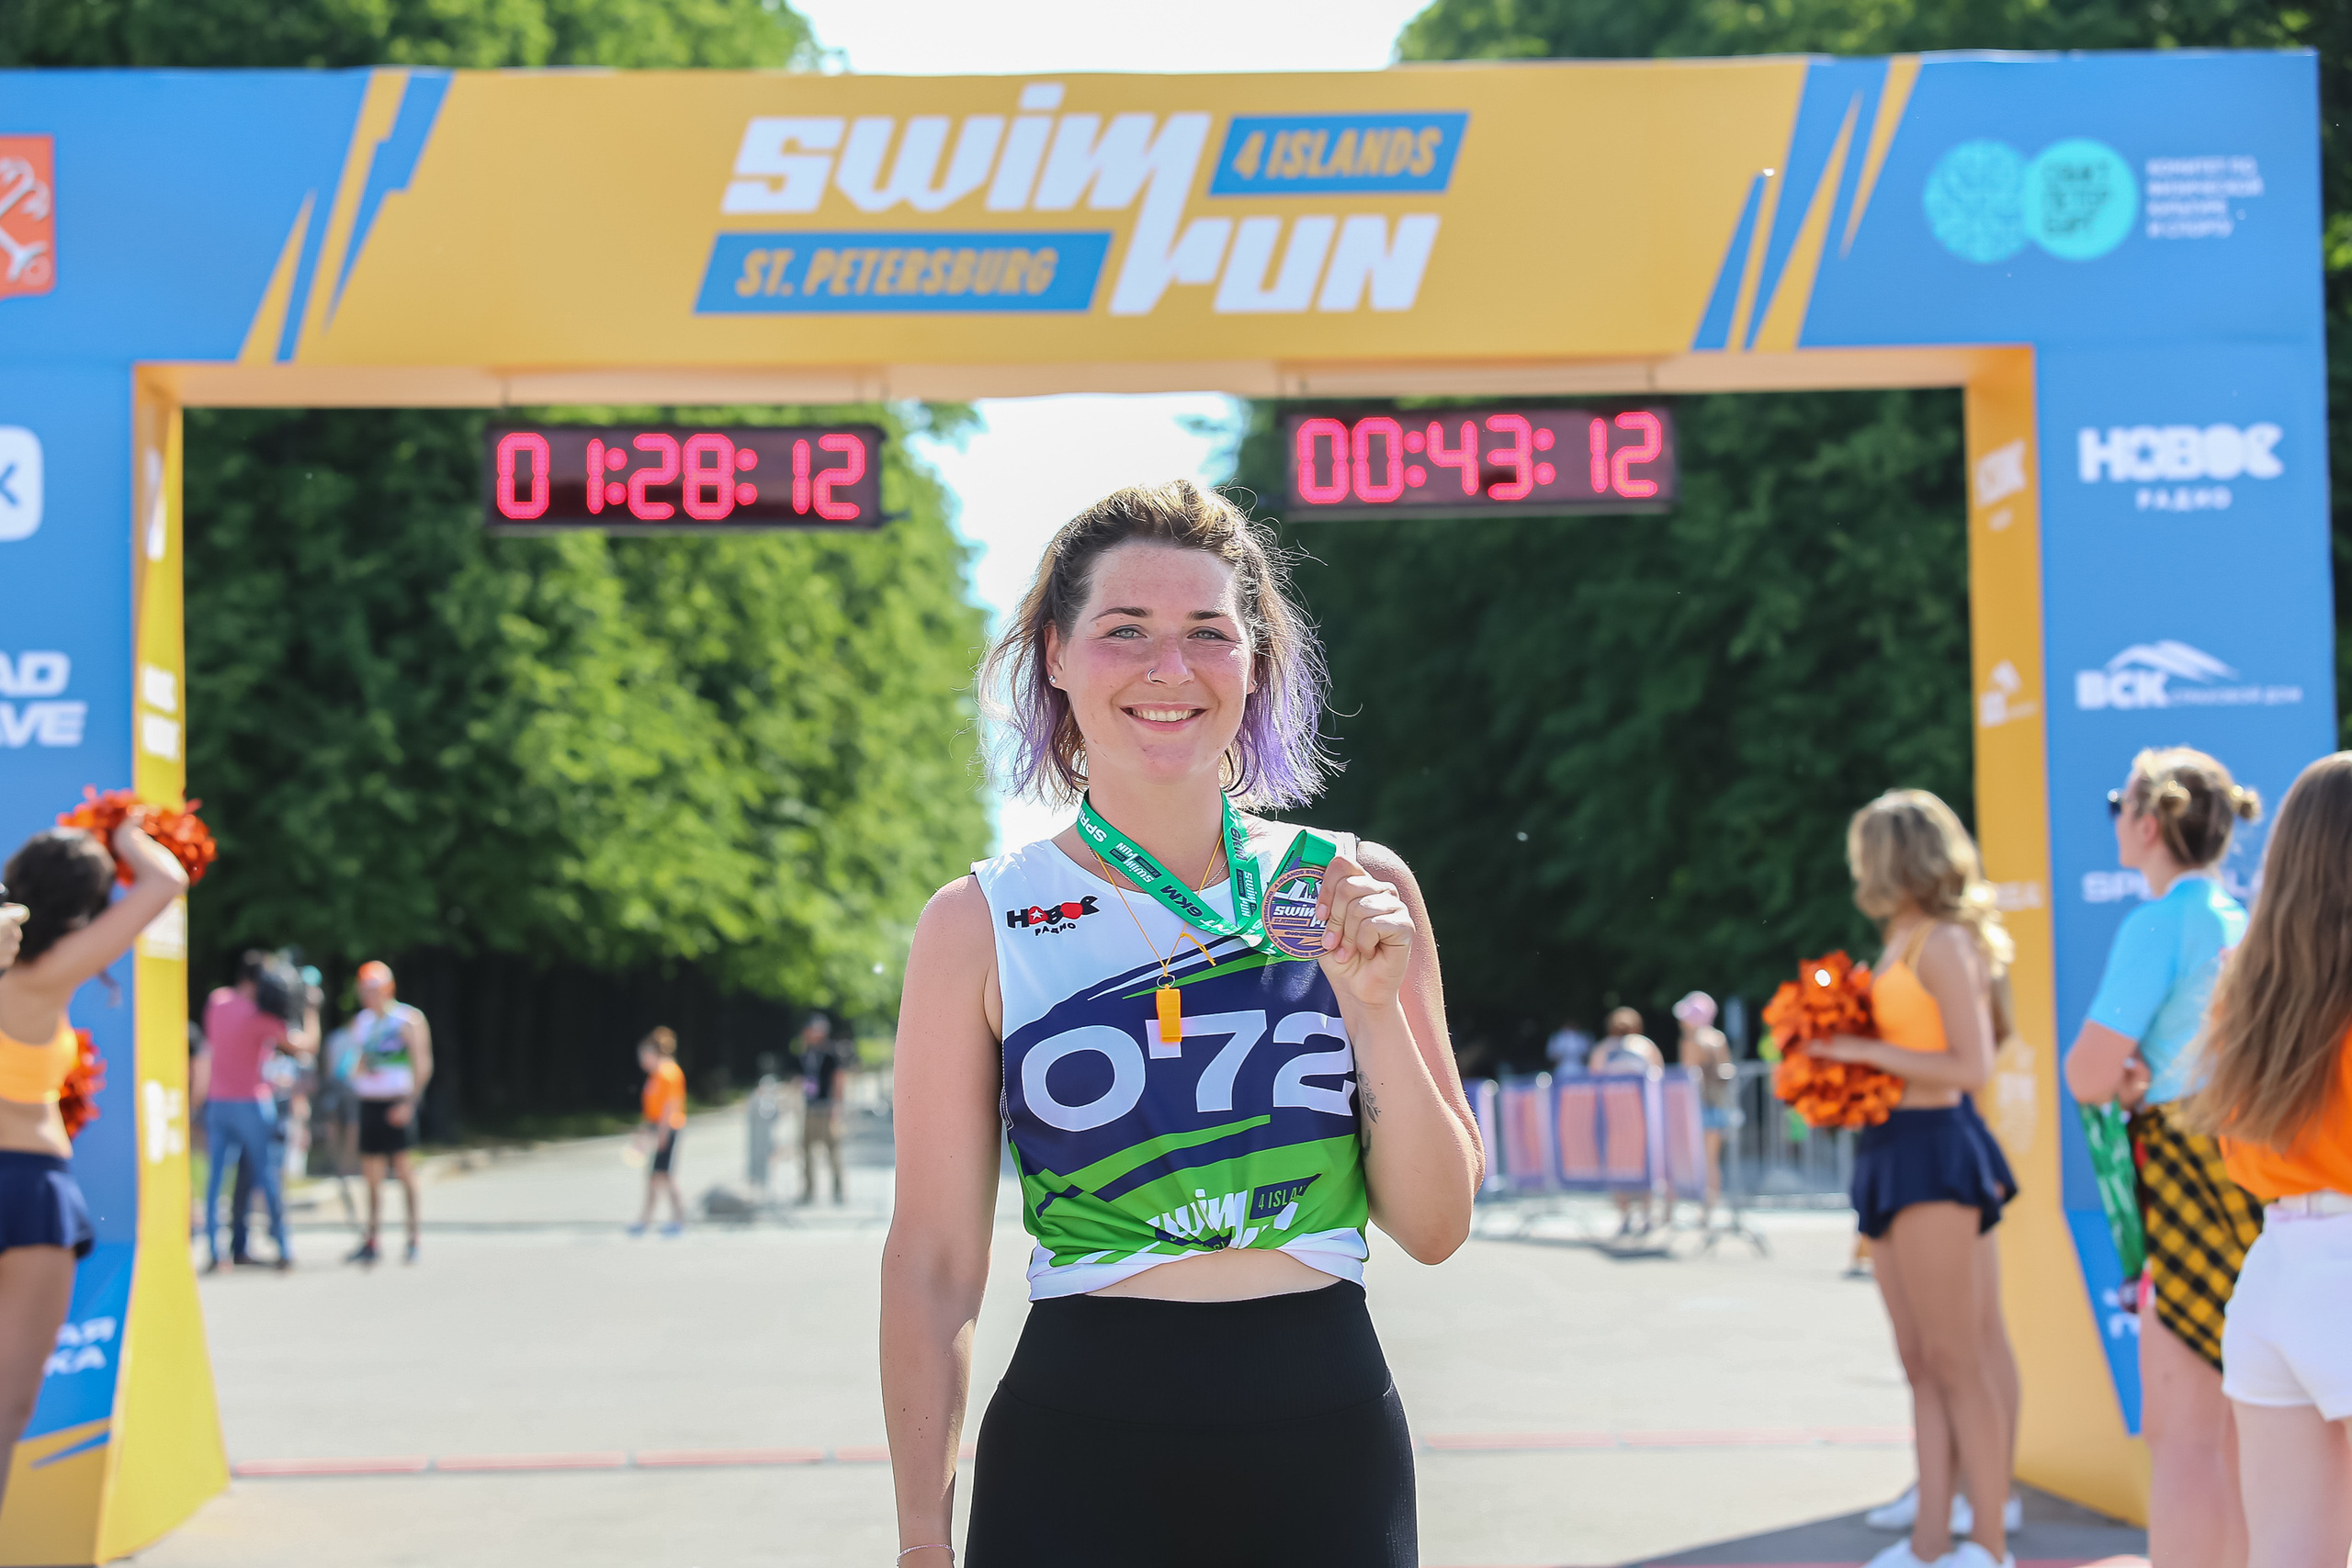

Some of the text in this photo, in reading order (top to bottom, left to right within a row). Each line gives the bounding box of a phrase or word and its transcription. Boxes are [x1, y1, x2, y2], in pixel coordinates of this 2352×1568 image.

[1232, 128, 1442, 179] 4 ISLANDS
[736, 247, 1057, 297] ST. PETERSBURG
[1035, 922, 1077, 936] РАДИО
[1022, 1010, 1356, 1132] 072
[1259, 1197, 1264, 1210] 4
